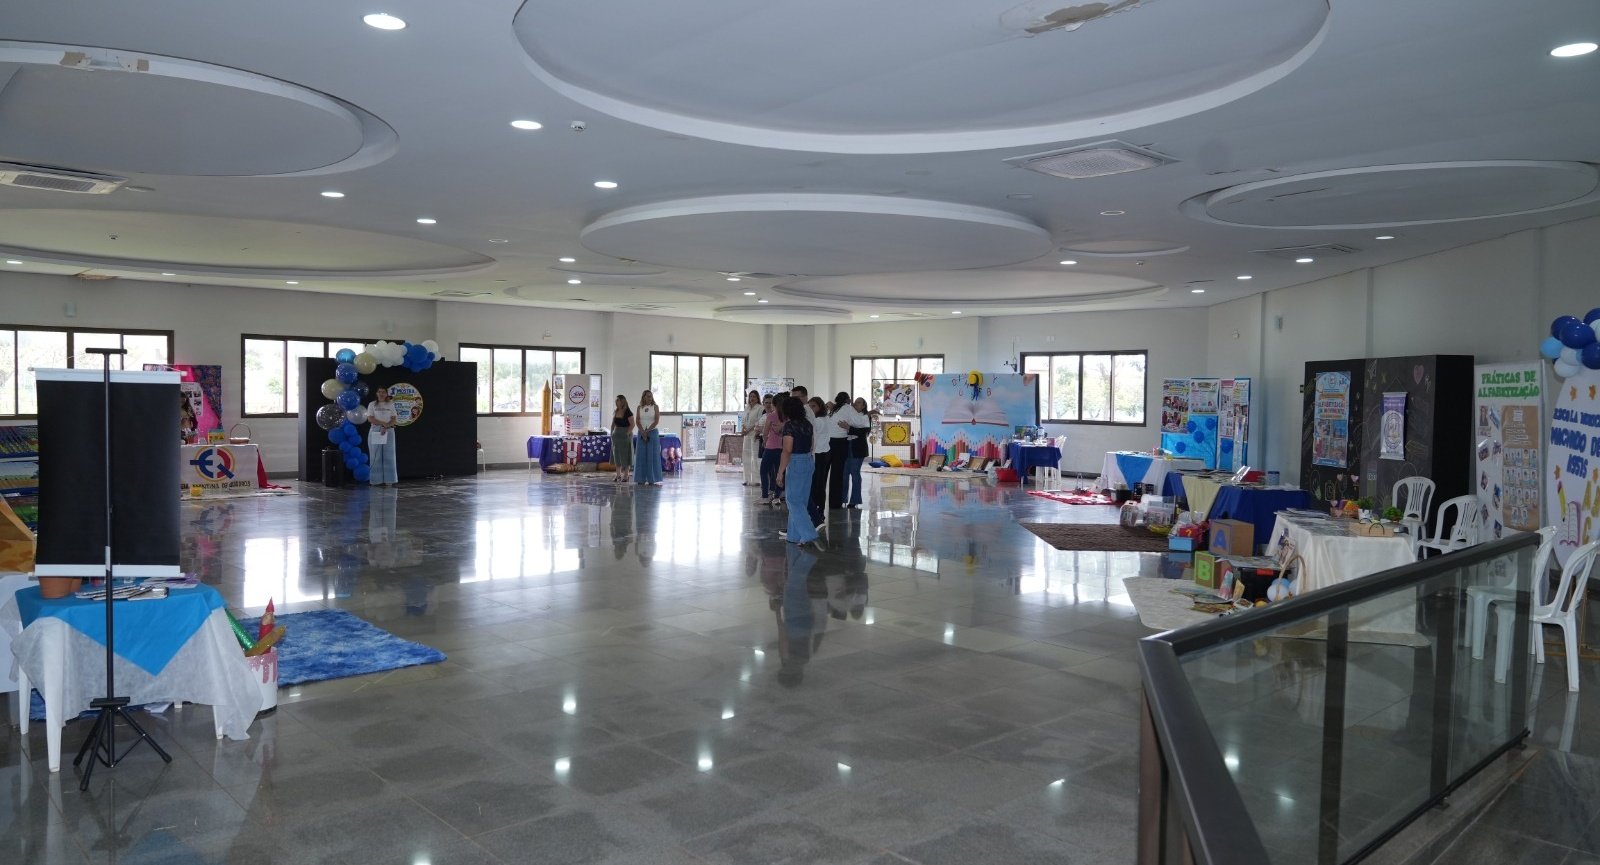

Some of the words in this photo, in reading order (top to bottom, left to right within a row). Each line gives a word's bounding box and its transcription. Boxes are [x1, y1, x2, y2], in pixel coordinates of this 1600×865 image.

[1481, 370, 1520, 384] PRÁTICAS
[1524, 371, 1536, 382] DE
[1478, 383, 1539, 400] ALFABETIZAÇÃO
[1553, 408, 1578, 423] ESCOLA
[1567, 454, 1588, 479] ASSIS
[1213, 528, 1227, 550] A
[1198, 560, 1211, 580] B
